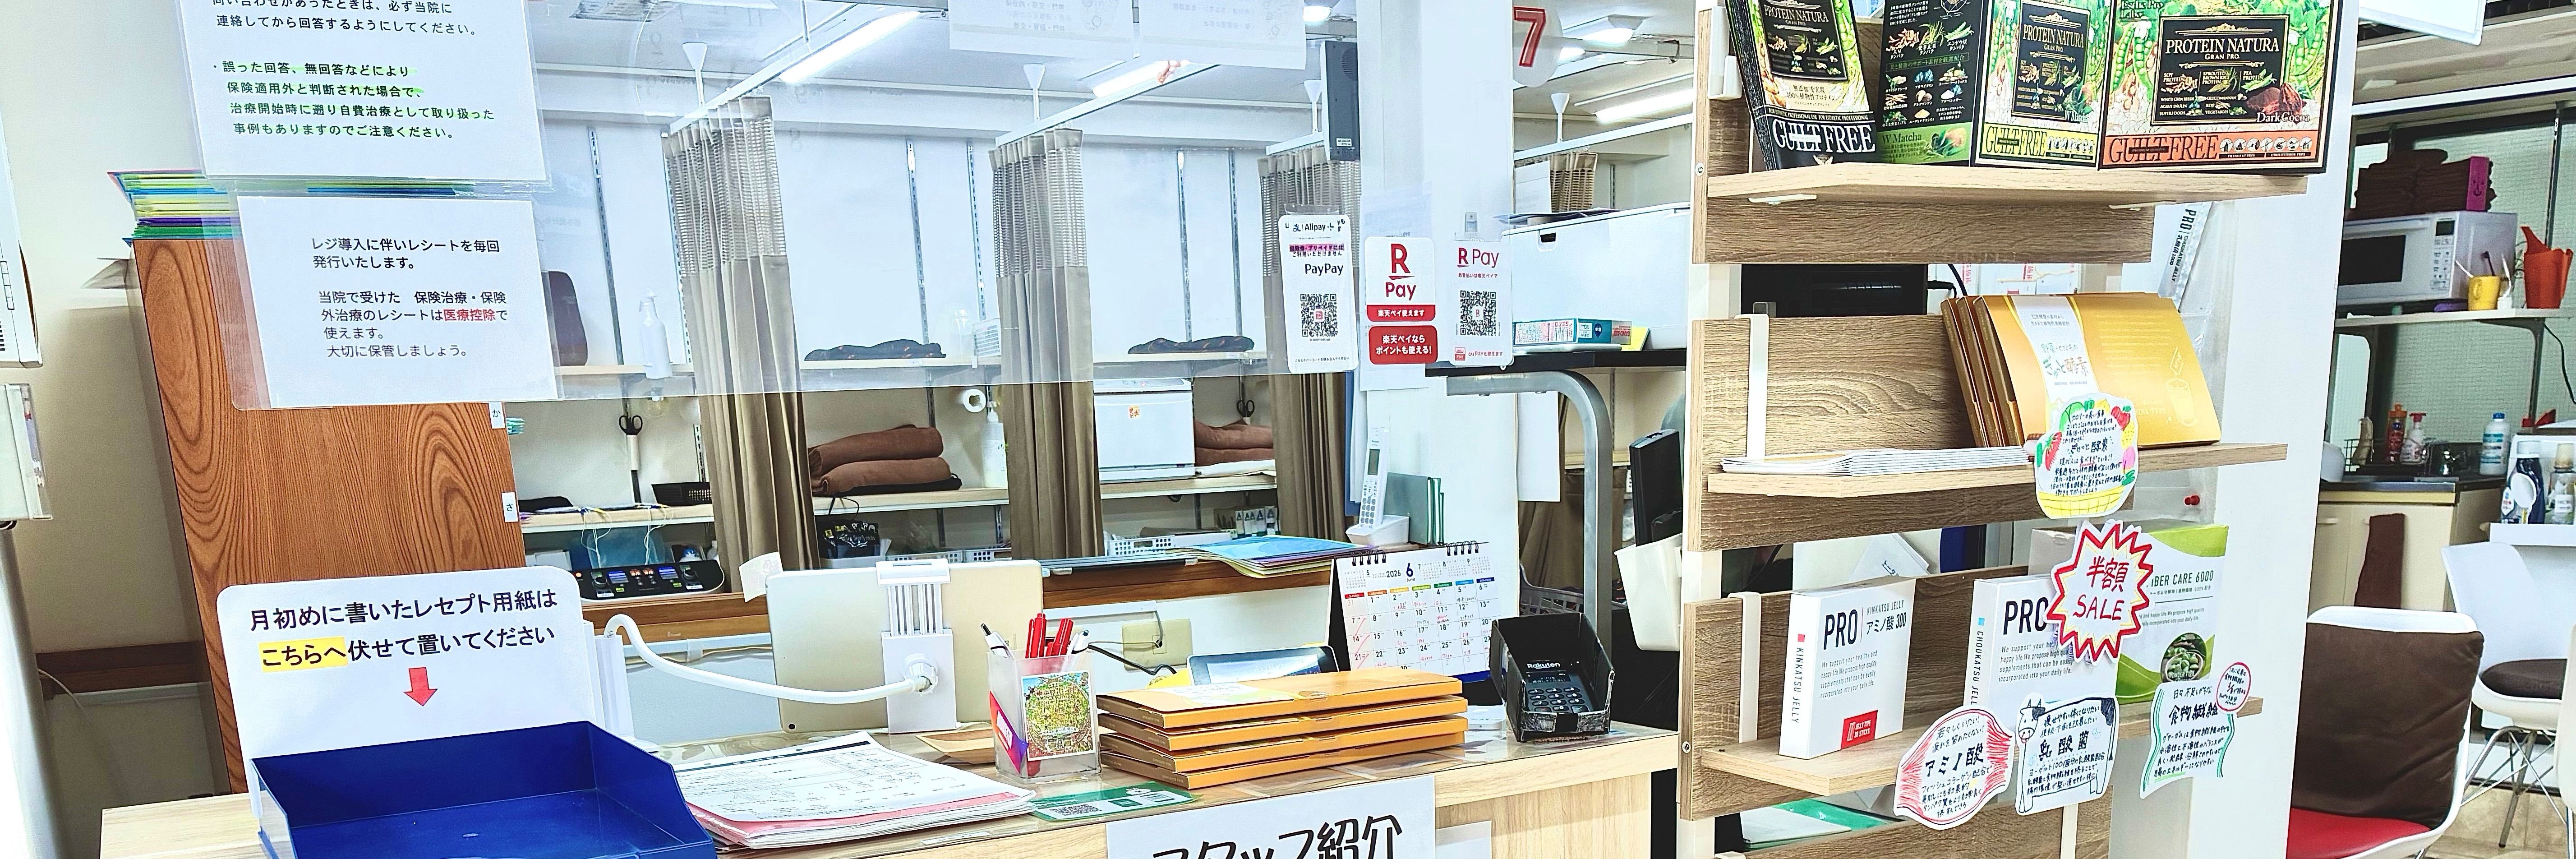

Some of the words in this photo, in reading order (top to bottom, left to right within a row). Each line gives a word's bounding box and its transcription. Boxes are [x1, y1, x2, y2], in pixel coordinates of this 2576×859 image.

[1764, 5, 1795, 19] PROTEIN
[1796, 10, 1829, 22] NATURA
[217, 15, 476, 36] 連絡してから回答するようにしてください。
[1514, 6, 1547, 68] 7
[2023, 24, 2056, 44] PROTEIN
[2056, 29, 2084, 48] NATURA
[2166, 38, 2227, 54] PROTEIN
[2227, 38, 2280, 52] NATURA
[227, 82, 422, 98] 保険適用外と判断された場合で、
[230, 102, 494, 120] 治療開始時に遡り自費治療として取り扱った
[2257, 112, 2280, 123] Dark
[2281, 112, 2310, 122] Cocoa
[234, 123, 454, 139] 事例もありますのでご注意ください。
[1772, 119, 1821, 152] GUILT
[1820, 124, 1876, 153] FREE
[1893, 132, 1922, 143] Matcha
[1986, 126, 2019, 154] GUILT
[2018, 129, 2047, 157] FREE
[2109, 136, 2167, 163] GUILT
[2169, 135, 2219, 161] FREE
[2180, 209, 2196, 230] PRO
[312, 238, 499, 253] レジ導入に伴いレシートを毎回
[313, 255, 415, 270] 発行いたします。
[1390, 243, 1410, 273] R
[1459, 248, 1468, 264] R
[1473, 249, 1499, 268] Pay
[1304, 263, 1343, 275] PayPay
[318, 291, 401, 304] 当院で受けた
[414, 291, 506, 304] 保険治療・保険
[1386, 282, 1416, 300] Pay
[321, 309, 508, 322] 外治療のレシートは医療控除で
[1378, 309, 1425, 317] 楽天ペイ使えます
[324, 328, 385, 340] 使えます。
[1382, 335, 1425, 344] 楽天ペイなら
[327, 345, 467, 358] 大切に保管しましょう。
[1376, 345, 1432, 355] ポイントも使える!
[492, 409, 501, 417] か
[507, 503, 513, 512] さ
[1406, 563, 1414, 577] 6
[2087, 556, 2129, 592] 半額
[2147, 575, 2169, 587] IBER
[2173, 573, 2193, 585] CARE
[2196, 570, 2214, 582] 6000
[250, 589, 558, 631] 月初めに書いたレセプト用紙は
[1867, 603, 1889, 615] KINKATSU
[1891, 600, 1904, 610] JELLY
[2073, 594, 2124, 620] SALE
[1866, 615, 1894, 635] アミノ酸
[1896, 612, 1907, 629] 300
[2003, 597, 2049, 635] PRO
[1824, 610, 1858, 650] PRO
[263, 626, 555, 667] こちらへ伏せて置いてください
[2011, 644, 2031, 653] support
[1973, 631, 1984, 682] CHOUKATSU
[2032, 652, 2049, 660] propose
[1794, 647, 1804, 693] KINKATSU
[1999, 673, 2028, 683] incorporated
[2051, 669, 2062, 677] daily
[2000, 664, 2030, 673] supplements
[1971, 685, 1979, 705] JELL
[1792, 697, 1800, 723] JELLY
[2039, 730, 2089, 762] 乳酸菌
[1926, 743, 1984, 777] アミノ酸
[1153, 815, 1401, 859] フ紹介
